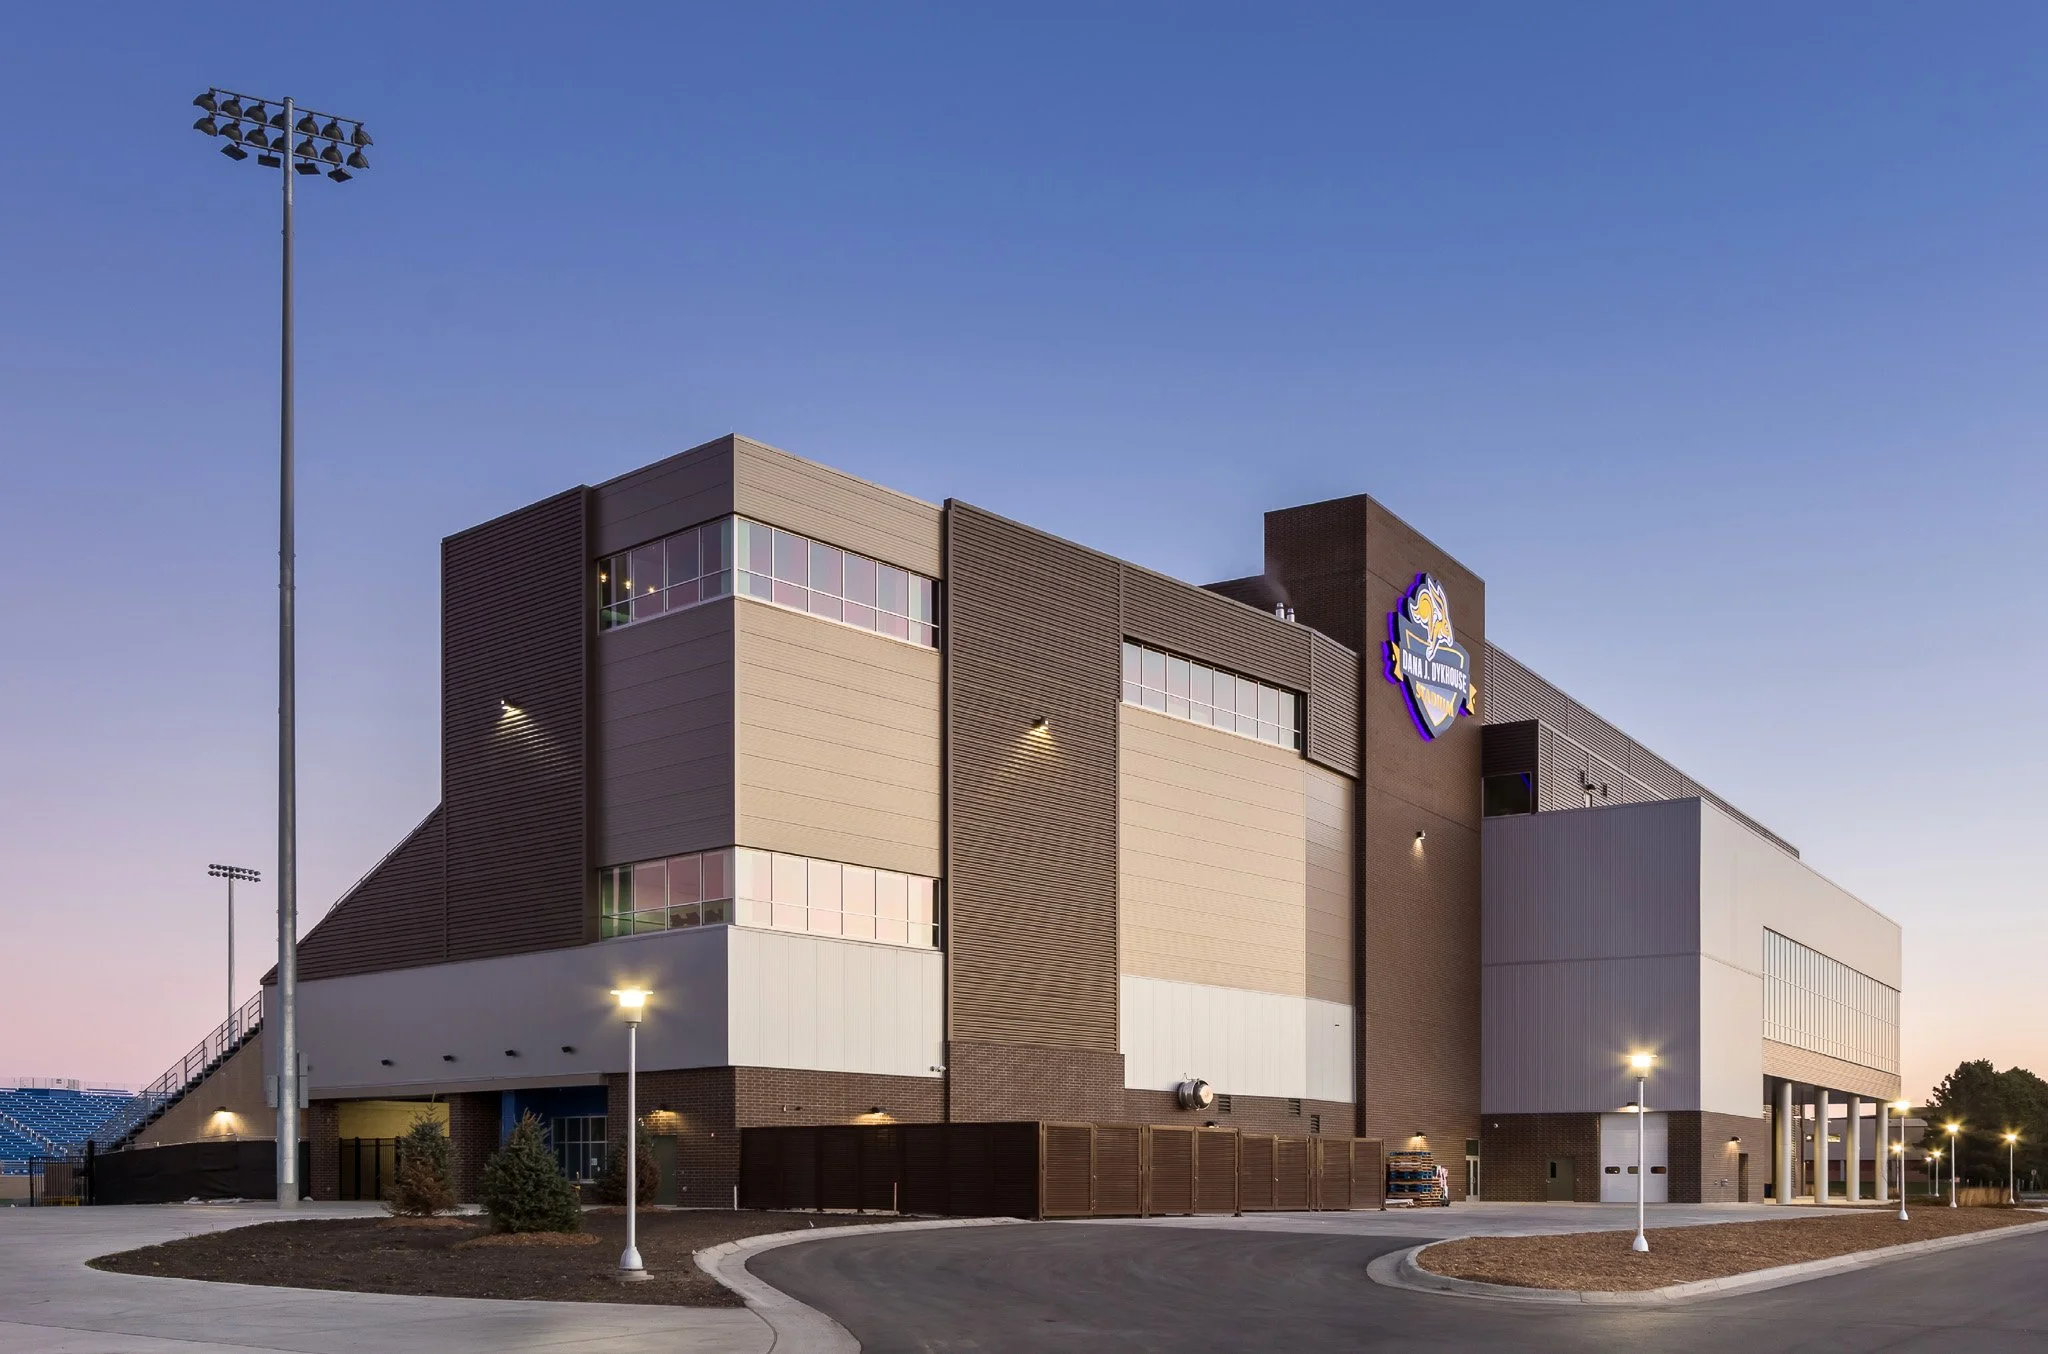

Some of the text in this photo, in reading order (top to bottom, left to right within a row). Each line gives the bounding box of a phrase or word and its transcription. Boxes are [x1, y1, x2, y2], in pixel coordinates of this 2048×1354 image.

[1402, 648, 1467, 694] DANA J. DYKHOUSE
